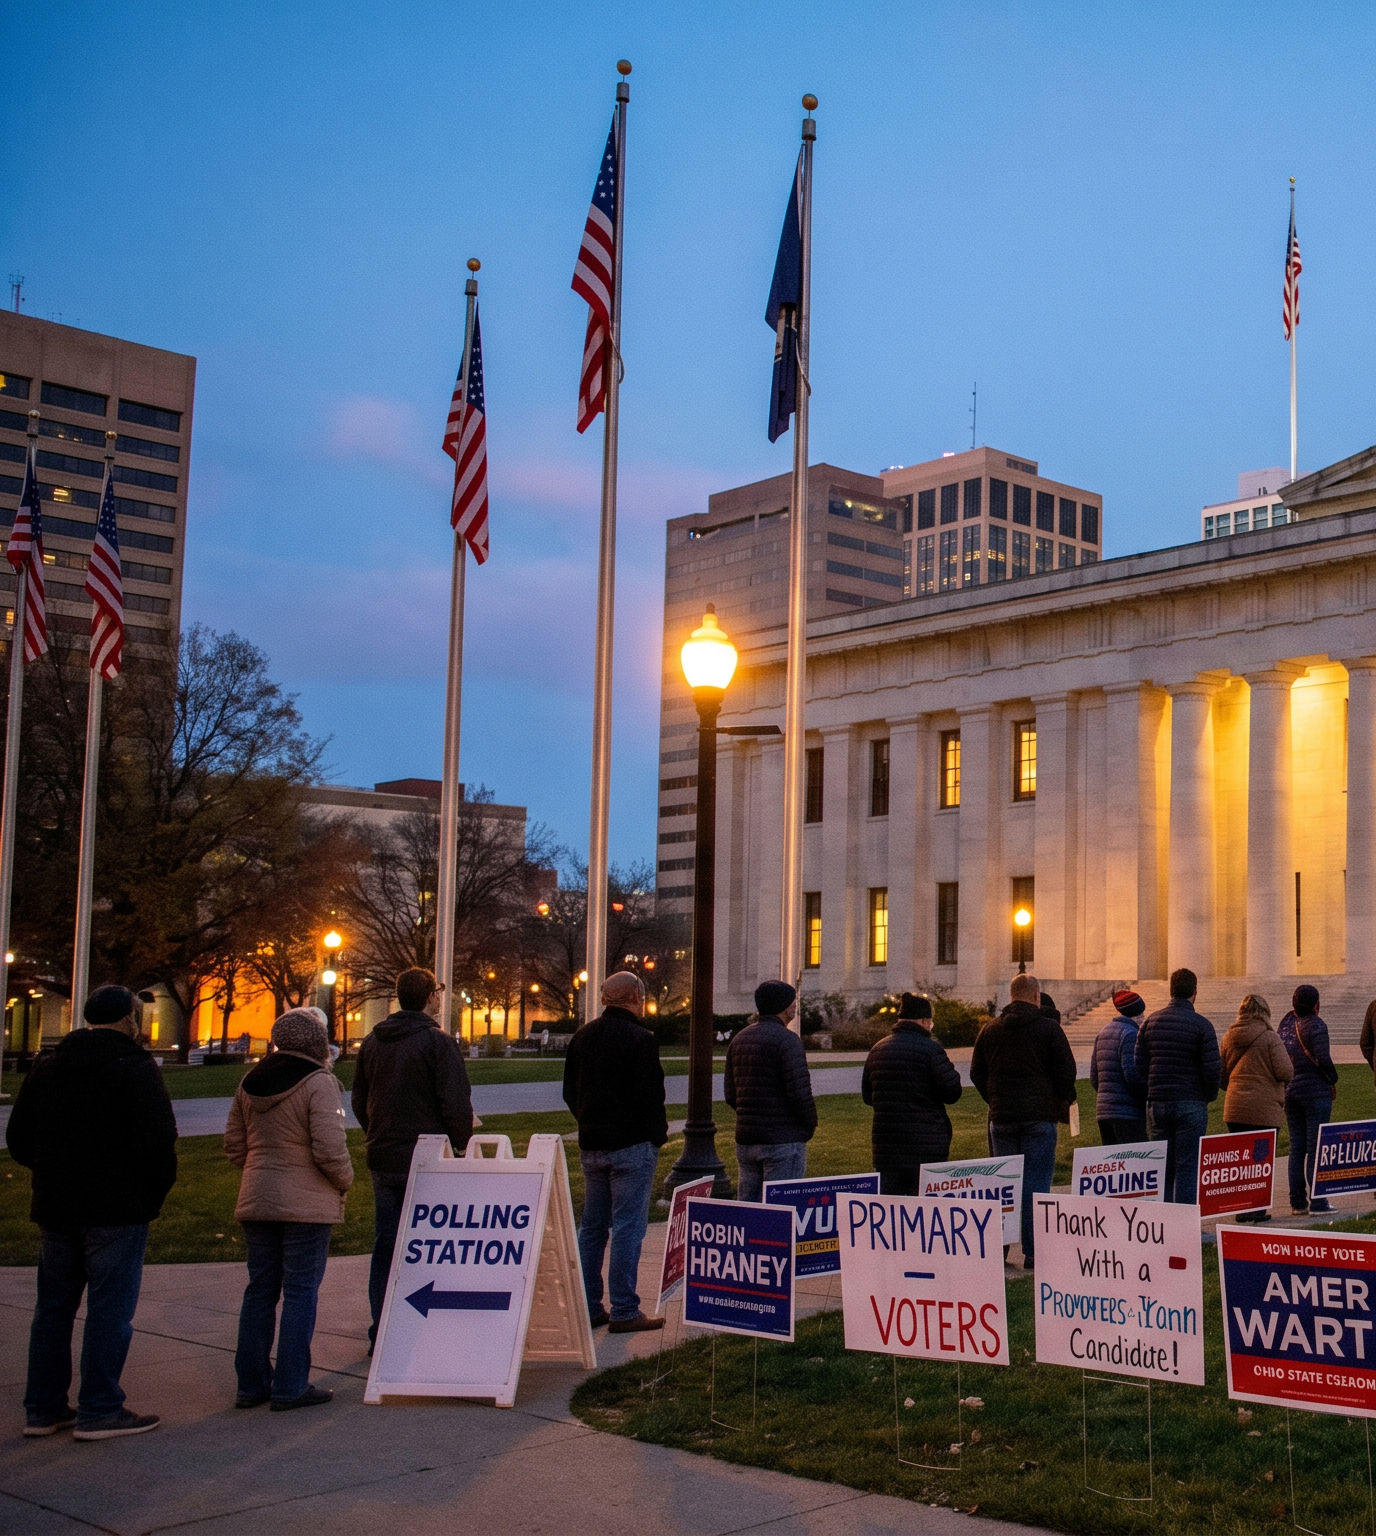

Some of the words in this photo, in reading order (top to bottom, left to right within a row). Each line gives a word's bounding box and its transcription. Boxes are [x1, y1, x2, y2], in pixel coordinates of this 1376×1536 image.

[411, 1203, 530, 1229] POLLING
[691, 1221, 745, 1246] ROBIN
[849, 1199, 993, 1259] PRIMARY
[1037, 1200, 1108, 1239] Thank
[1120, 1206, 1165, 1245] You
[405, 1238, 525, 1265] STATION
[690, 1246, 788, 1287] HRANEY
[1077, 1247, 1125, 1280] With
[1138, 1263, 1152, 1282] a
[1263, 1271, 1371, 1312] AMER
[870, 1294, 1001, 1358] VOTERS
[1288, 1369, 1324, 1384] STATE
